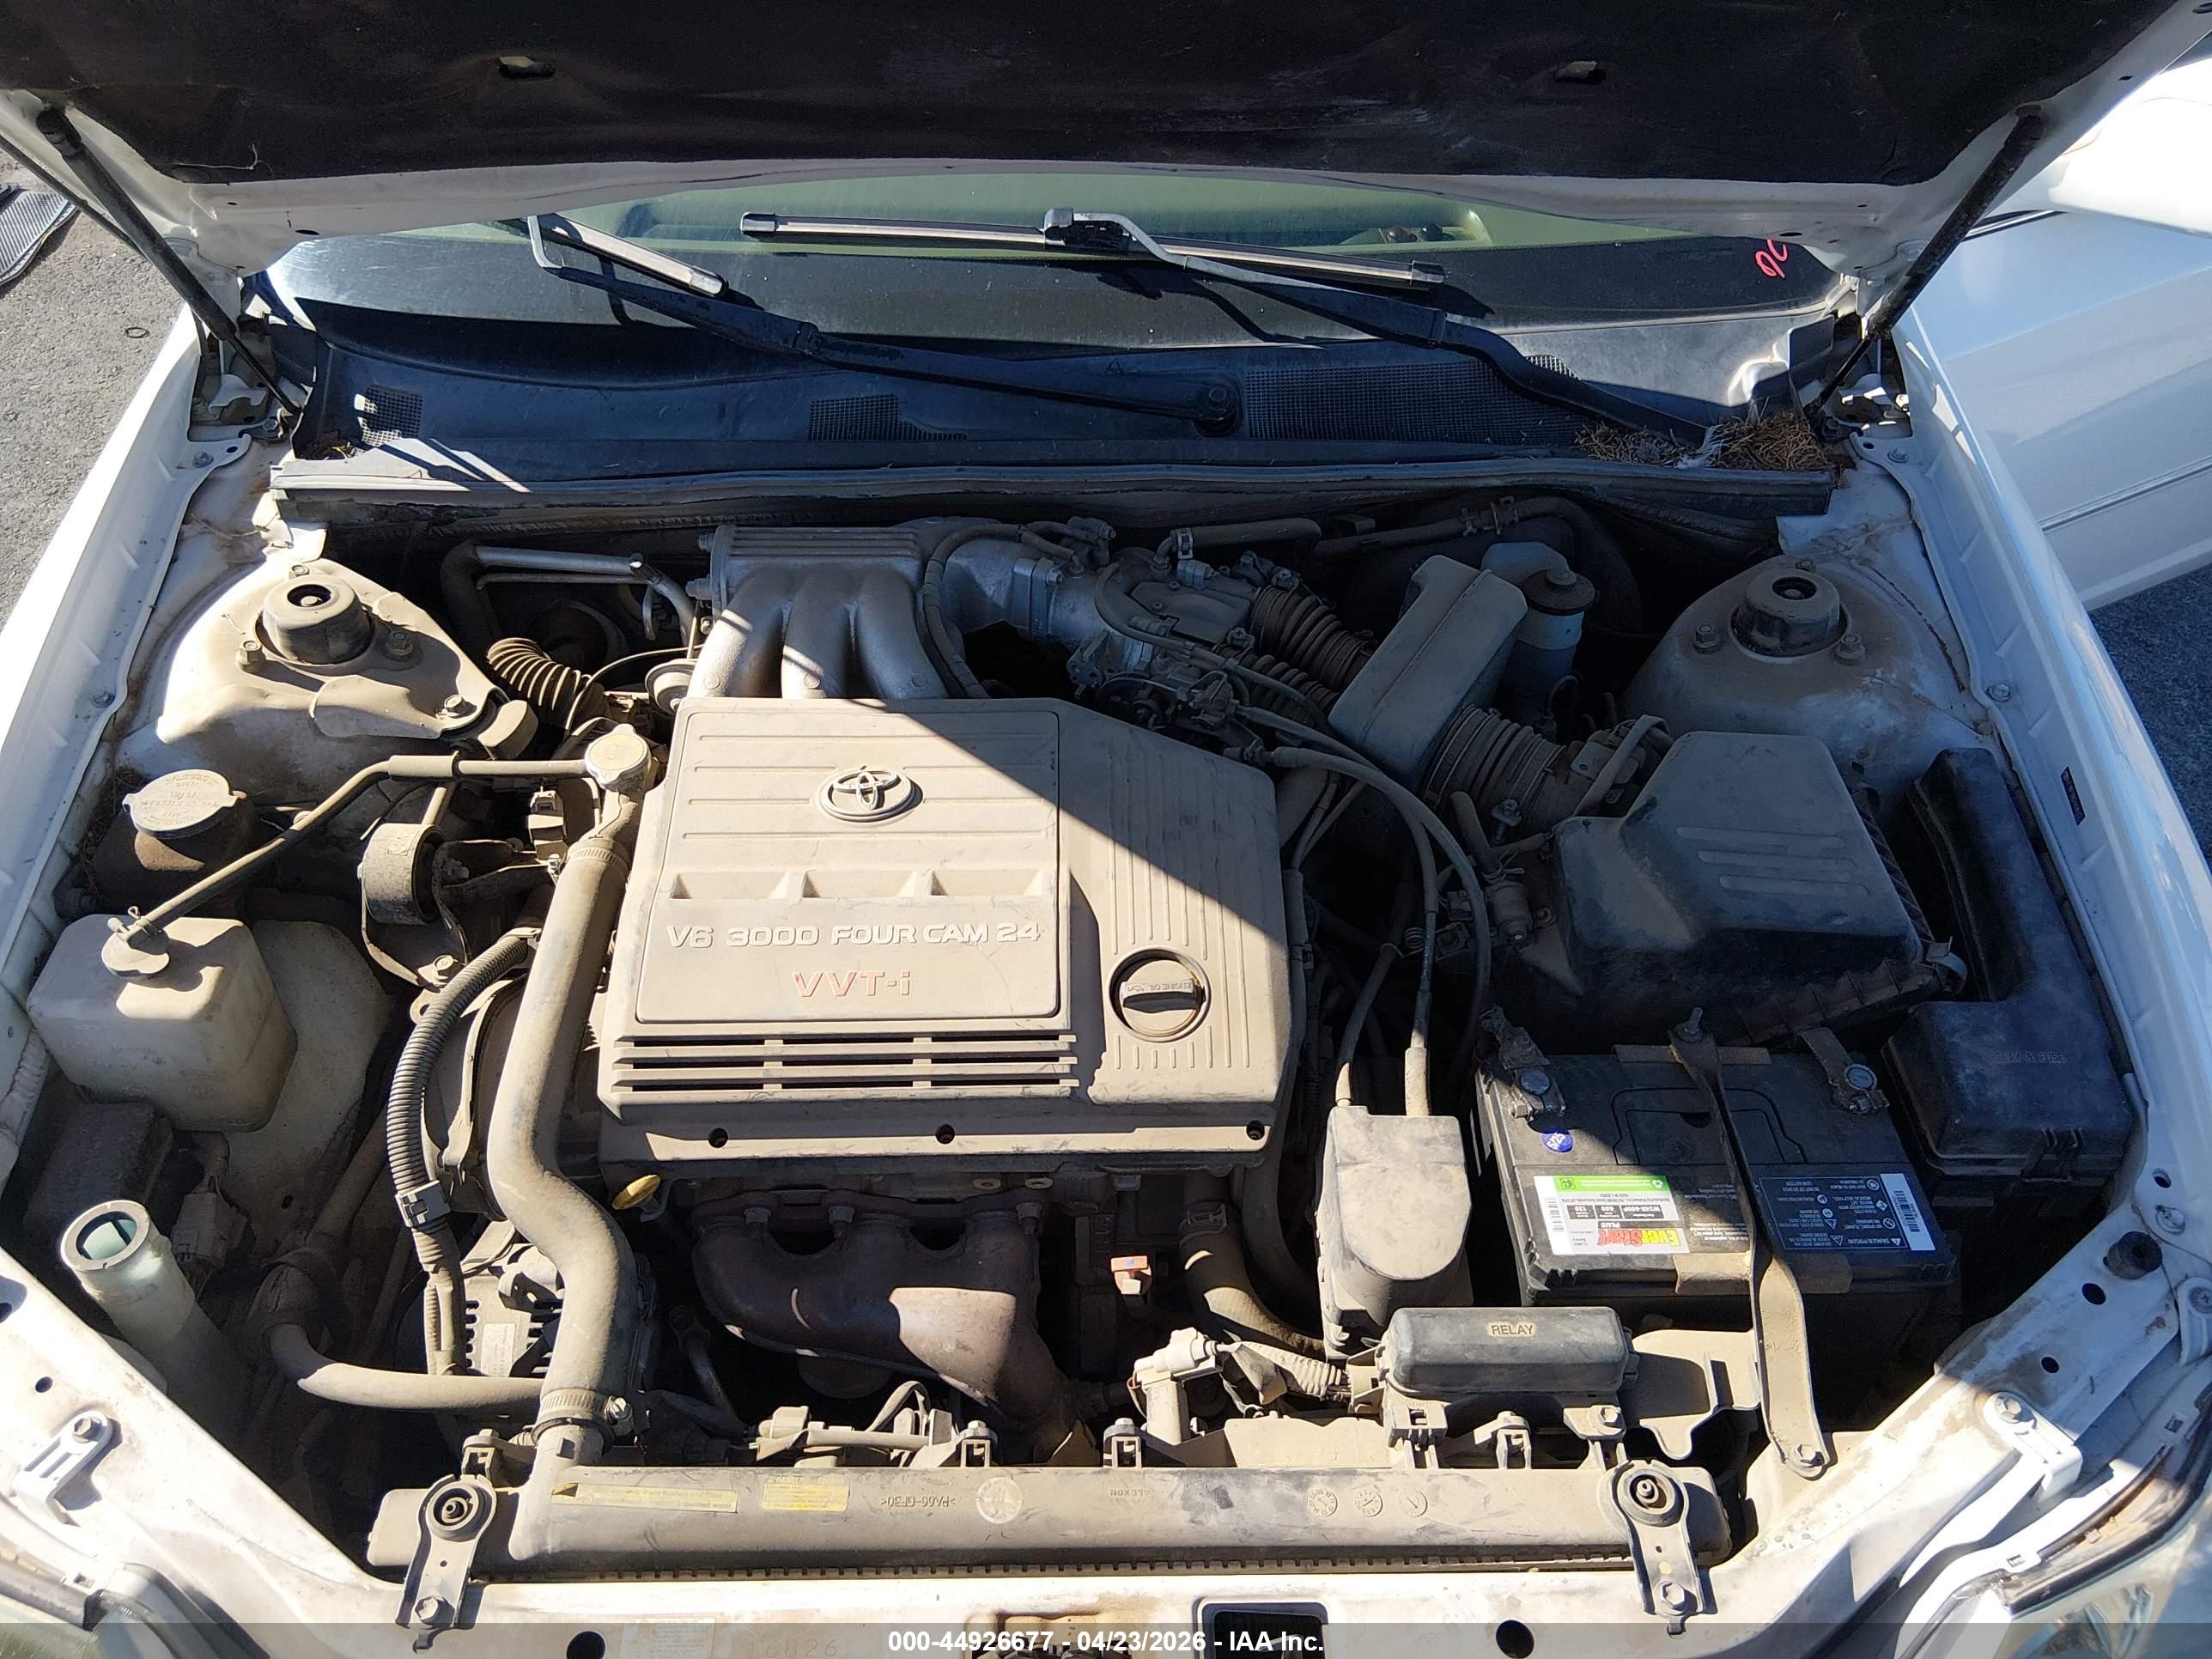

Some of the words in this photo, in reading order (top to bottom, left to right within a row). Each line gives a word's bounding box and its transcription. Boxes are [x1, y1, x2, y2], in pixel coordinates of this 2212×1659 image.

[666, 924, 714, 947] V6
[726, 924, 819, 946] 3000
[831, 923, 916, 945] FOUR
[923, 922, 989, 943] CAM
[996, 921, 1042, 942] 24
[791, 969, 913, 997] VVT-i
[1597, 1229, 1680, 1248] EverStart
[1491, 1324, 1534, 1334] RELAY
